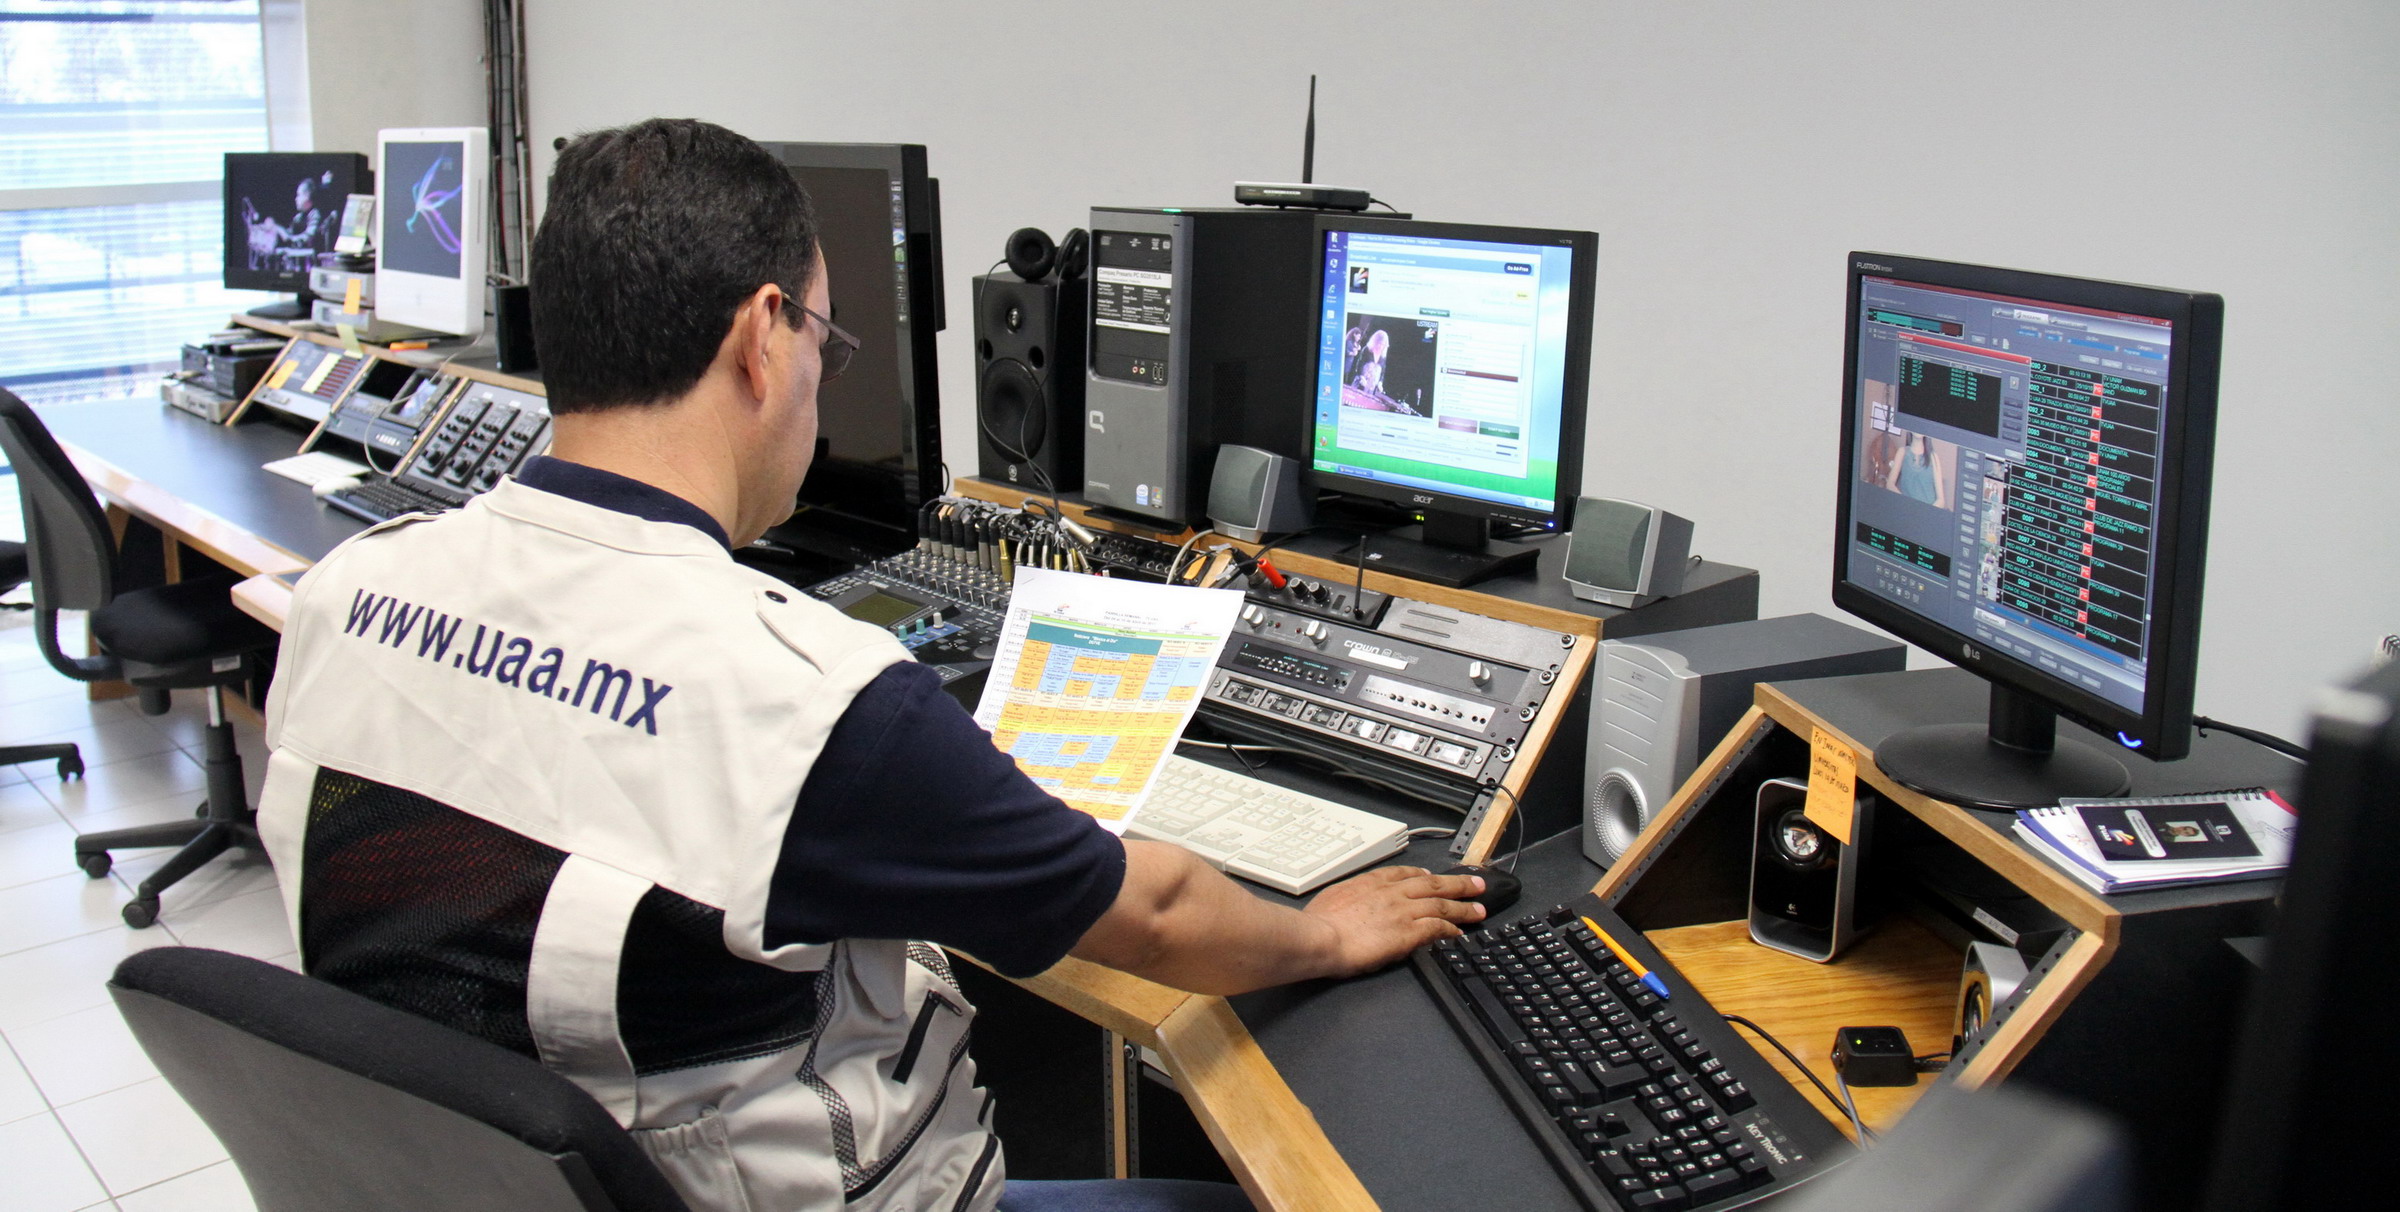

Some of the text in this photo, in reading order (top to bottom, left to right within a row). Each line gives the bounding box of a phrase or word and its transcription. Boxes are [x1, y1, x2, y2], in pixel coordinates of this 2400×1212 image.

[1413, 494, 1434, 504] acer
[1344, 640, 1380, 654] crown
[343, 588, 673, 736] www.uaa.mx
[1745, 1123, 1788, 1165] KEY TRONIC
